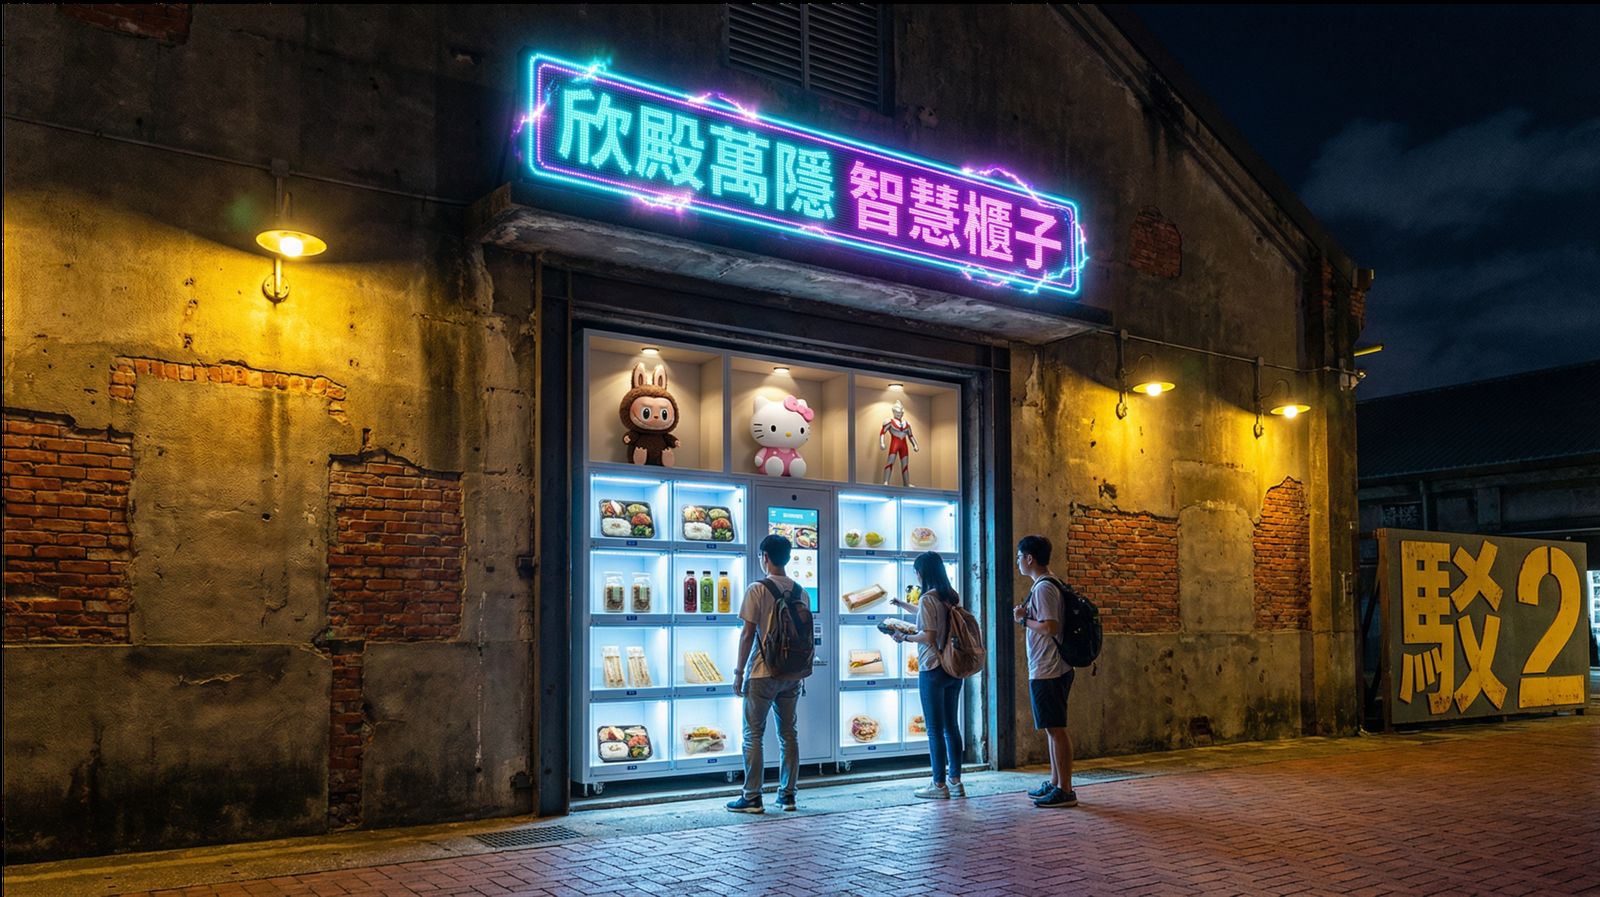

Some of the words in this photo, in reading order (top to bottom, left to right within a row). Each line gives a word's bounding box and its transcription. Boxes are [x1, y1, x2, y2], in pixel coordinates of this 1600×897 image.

[558, 88, 836, 220] 欣殿萬隱
[849, 160, 1063, 271] 智慧櫃子
[1400, 540, 1586, 714] 駁2
